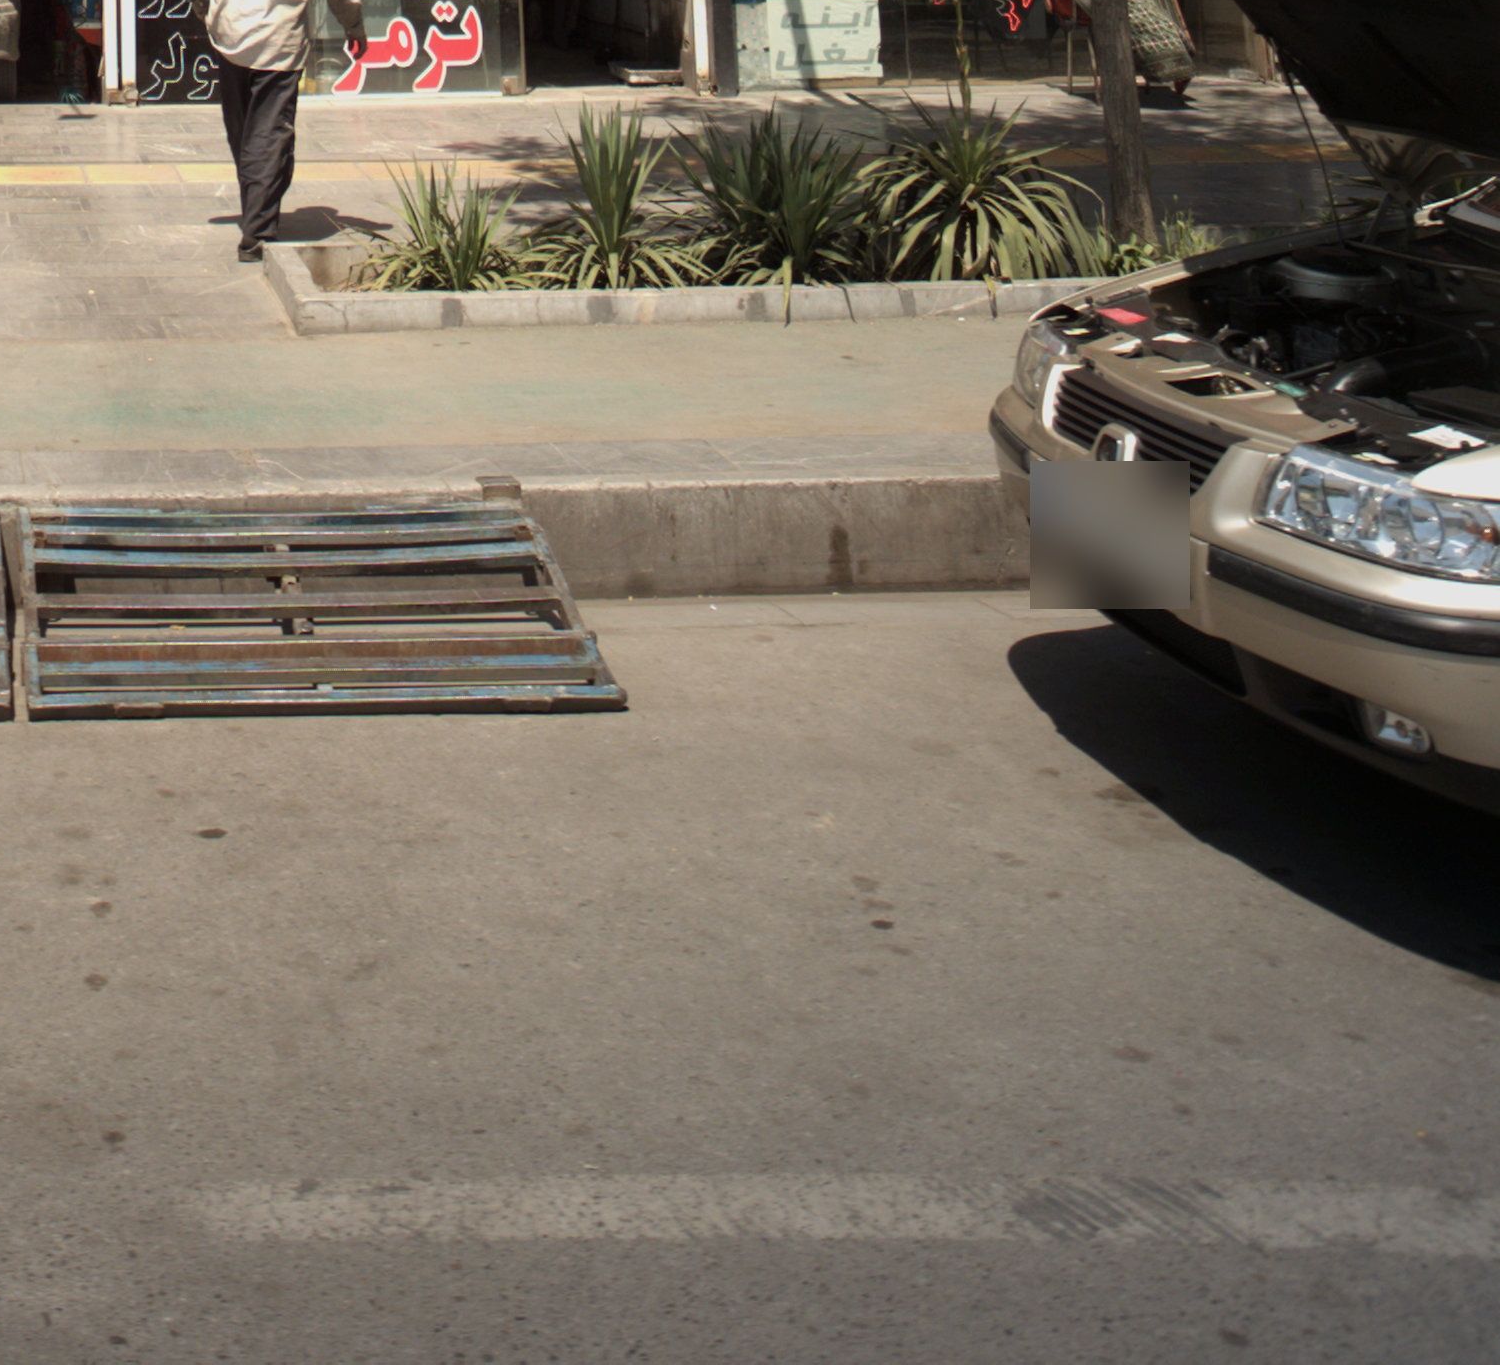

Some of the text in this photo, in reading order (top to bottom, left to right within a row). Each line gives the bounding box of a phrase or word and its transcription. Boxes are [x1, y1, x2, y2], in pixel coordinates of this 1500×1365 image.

[781, 1, 876, 36] آینه
[140, 31, 219, 100] ولر
[775, 43, 876, 71] بغل
